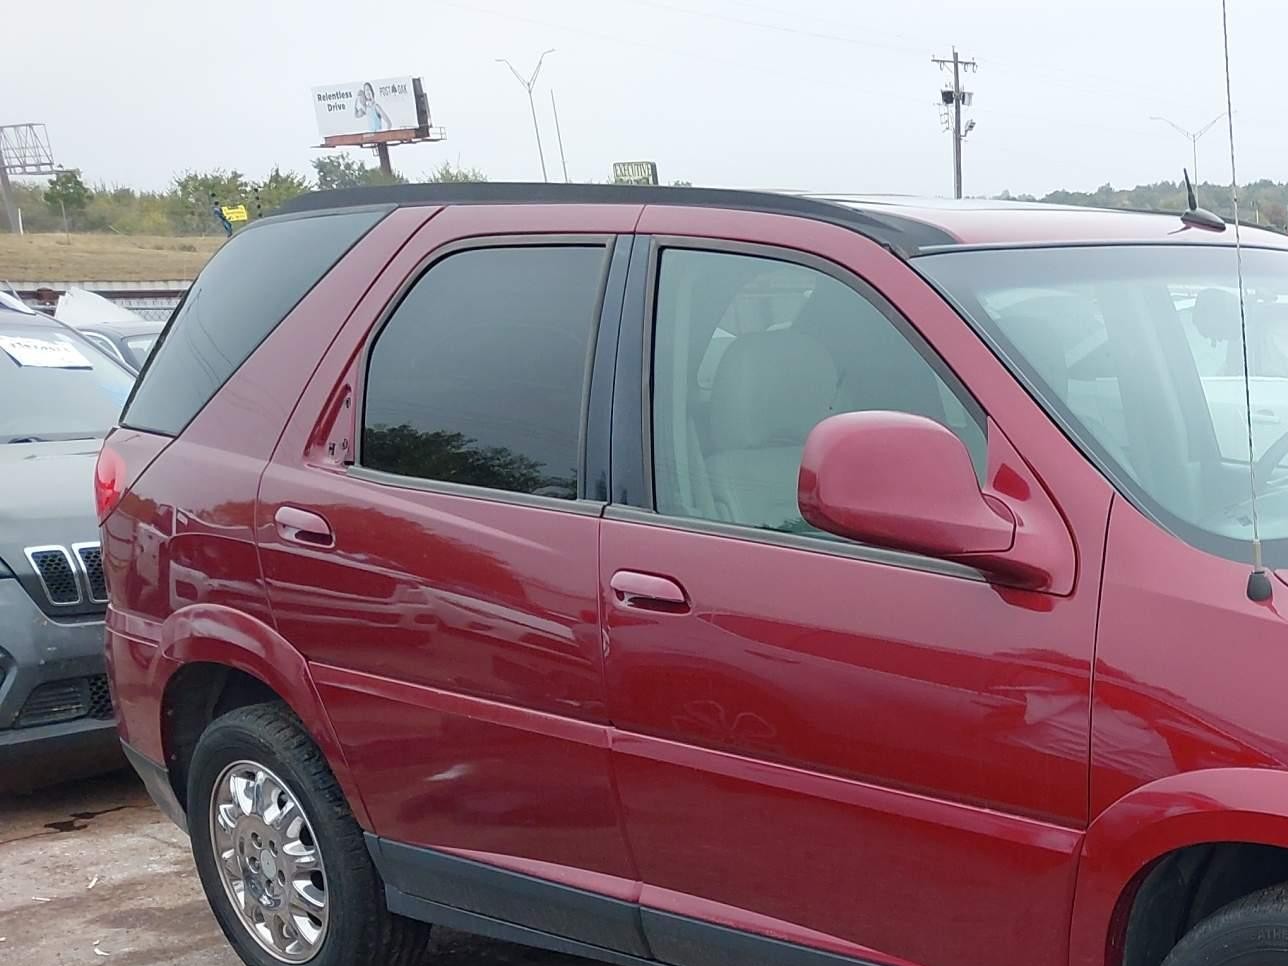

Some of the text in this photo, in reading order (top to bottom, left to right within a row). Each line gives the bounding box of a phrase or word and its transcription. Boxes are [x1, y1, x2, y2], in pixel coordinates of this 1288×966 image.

[317, 90, 353, 102] Relentless
[327, 102, 346, 112] Drive
[615, 163, 652, 177] EXECUTIVE
